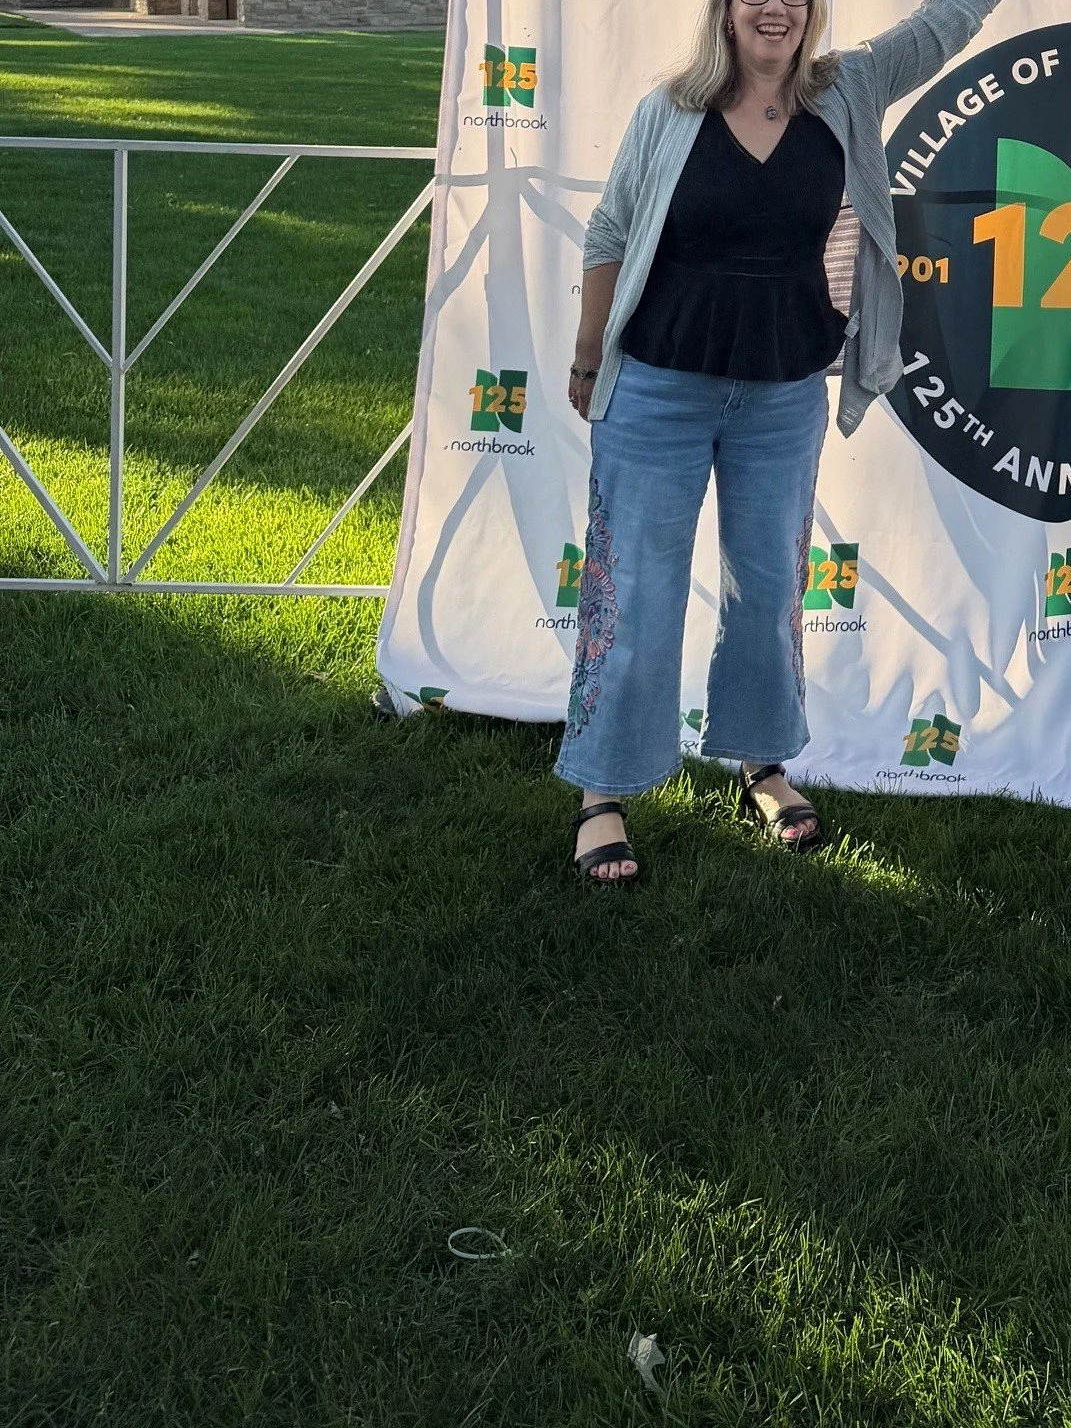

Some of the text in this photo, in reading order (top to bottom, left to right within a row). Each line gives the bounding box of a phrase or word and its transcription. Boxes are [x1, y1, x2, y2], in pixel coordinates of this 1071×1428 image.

[479, 61, 537, 90] 125
[464, 112, 547, 130] northbrook
[890, 73, 1005, 196] VILLAGE
[1011, 48, 1060, 85] OF
[897, 254, 950, 284] 901
[469, 385, 527, 414] 125
[903, 351, 995, 447] 125TH
[450, 438, 535, 456] northbrook
[804, 615, 867, 632] rthbrook
[903, 727, 960, 752] 125
[876, 769, 966, 783] northbrook
